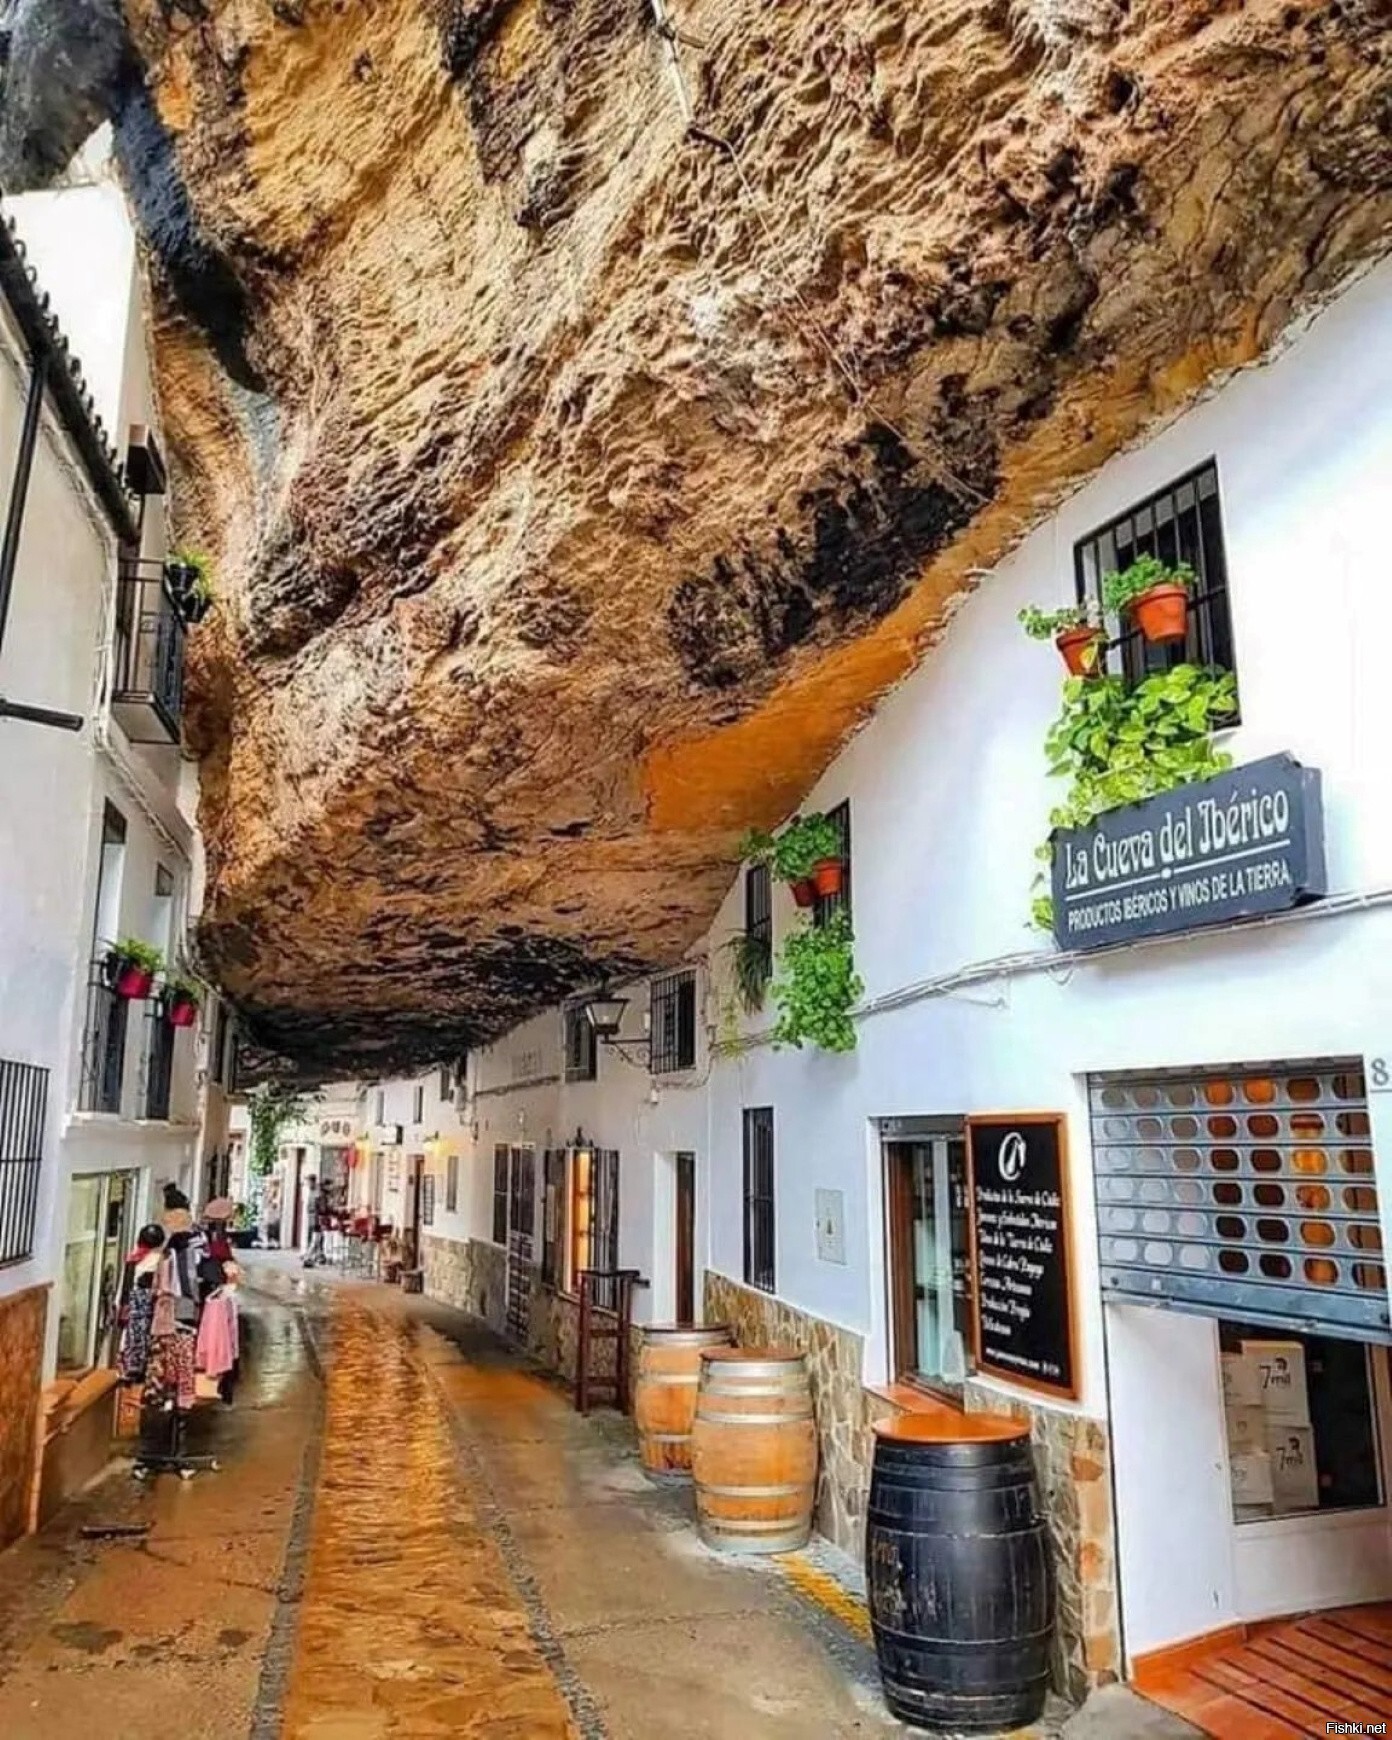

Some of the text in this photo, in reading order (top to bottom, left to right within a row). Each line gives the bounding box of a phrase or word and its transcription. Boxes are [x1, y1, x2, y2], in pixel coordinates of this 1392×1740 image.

[1065, 843, 1089, 889] La
[1093, 831, 1155, 881] Cueva
[1160, 806, 1193, 863] del
[1068, 899, 1122, 933] PRODUCTOS
[1168, 885, 1178, 912] Y
[1178, 877, 1210, 909] VINOS
[1212, 873, 1228, 901] DE
[1229, 869, 1246, 897] LA
[1246, 857, 1293, 894] TIERRA
[1371, 1058, 1389, 1087] 8
